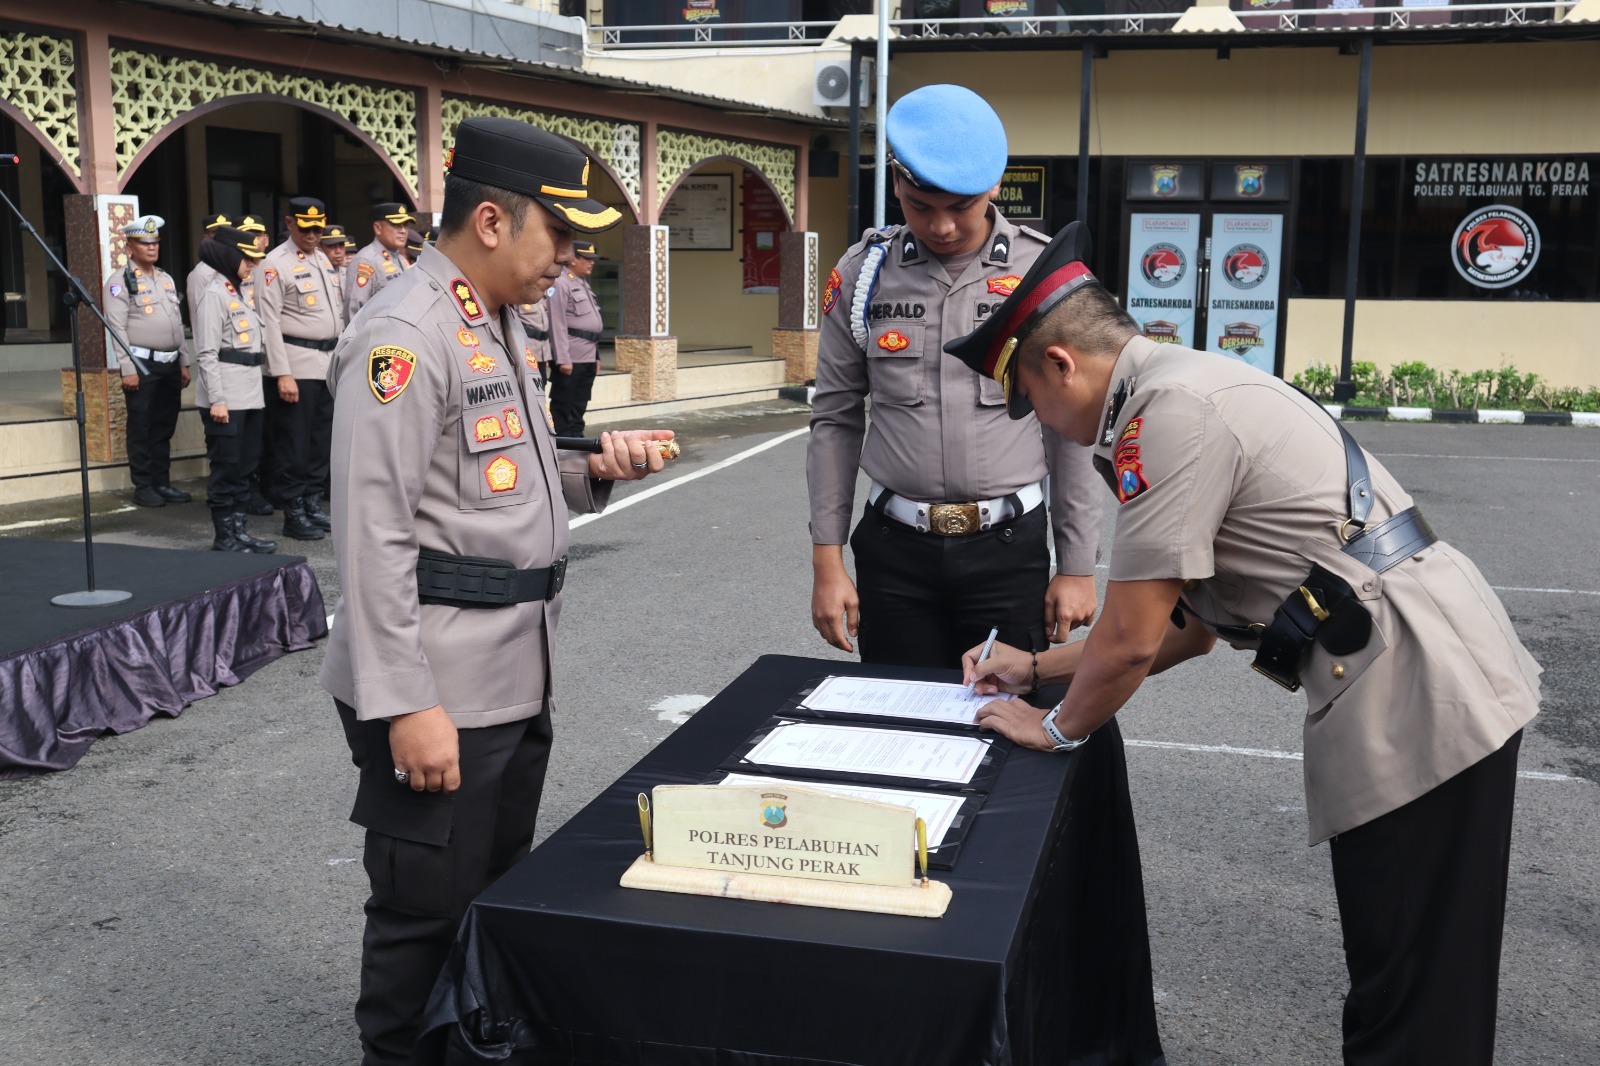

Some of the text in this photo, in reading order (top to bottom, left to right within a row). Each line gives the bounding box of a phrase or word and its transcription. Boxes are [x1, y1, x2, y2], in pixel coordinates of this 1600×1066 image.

[1003, 172, 1039, 182] NFORMASI
[1415, 162, 1590, 183] SATRESNARKOBA
[1414, 184, 1589, 197] POLRES PELABUHAN TG. PERAK
[1466, 213, 1488, 232] POLRES
[1488, 211, 1523, 225] PELABUHAN
[1467, 267, 1520, 282] SATRESNARKOBA
[869, 302, 926, 320] HERALD
[1130, 298, 1192, 309] SATRESNARKOBA
[1212, 299, 1275, 310] SATRESNARKOBA
[1222, 337, 1264, 349] BERSAHAJA
[375, 348, 412, 361] RESERSE
[466, 382, 506, 406] WAHYU
[505, 380, 514, 396] H
[688, 829, 880, 858] POLRES PELABUHAN
[706, 850, 860, 876] TANJUNG PERAK
